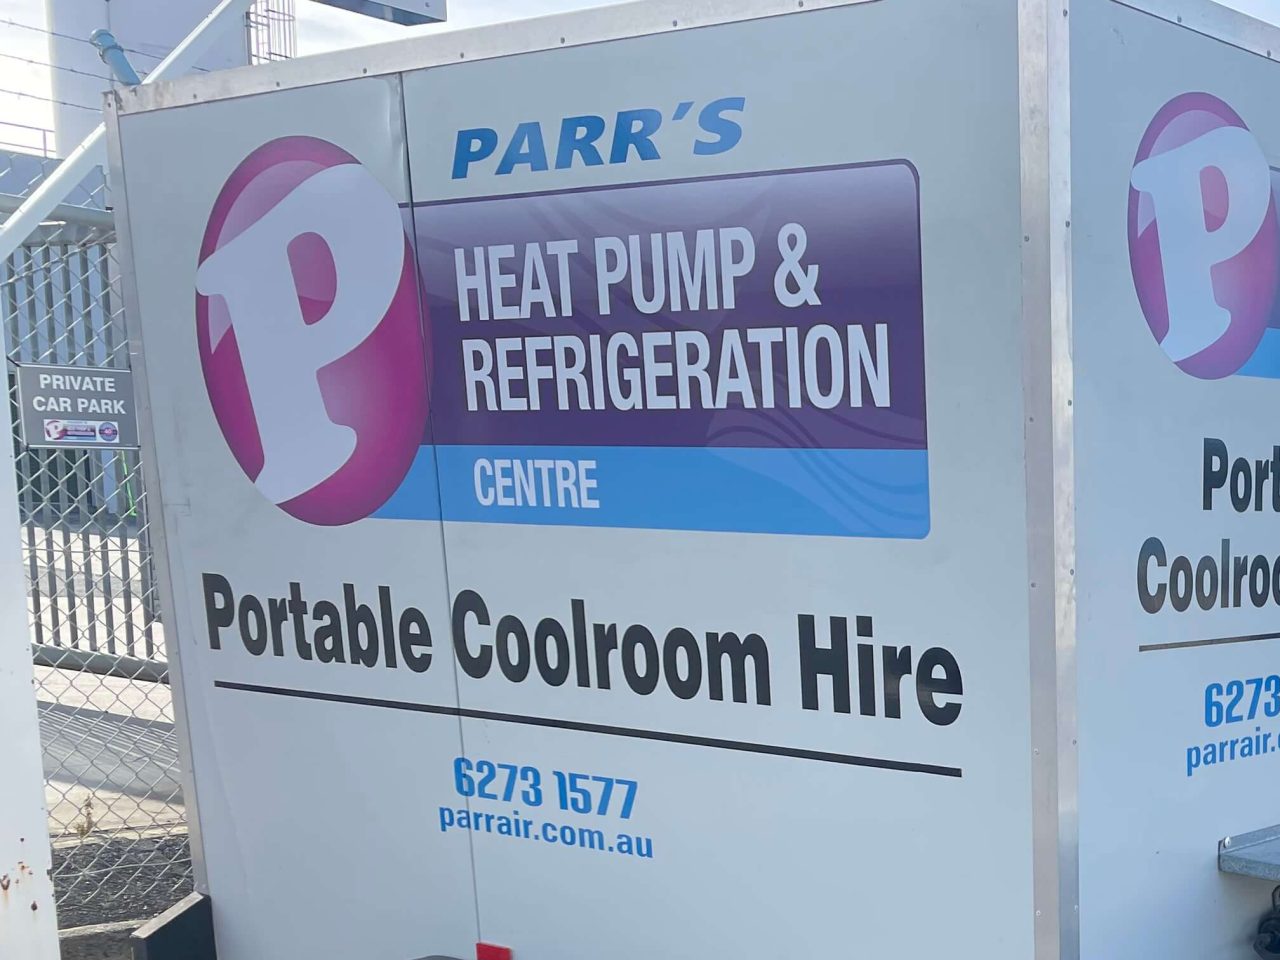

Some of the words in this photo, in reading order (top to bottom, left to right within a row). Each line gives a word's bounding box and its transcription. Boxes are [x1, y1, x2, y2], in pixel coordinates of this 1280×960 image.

[451, 97, 745, 179] PARR'S
[455, 239, 578, 321] HEAT
[596, 226, 755, 316] PUMP
[773, 222, 821, 307] &
[39, 374, 116, 392] PRIVATE
[462, 323, 890, 411] REFRIGERATION
[32, 396, 72, 412] CAR
[77, 398, 126, 414] PARK
[473, 458, 600, 508] CENTRE
[202, 573, 432, 673] Portable
[452, 589, 771, 706] Coolroom
[798, 614, 963, 726] Hire
[454, 757, 543, 806] 6273
[552, 770, 638, 819] 1577
[439, 807, 654, 858] parrair.com.au
